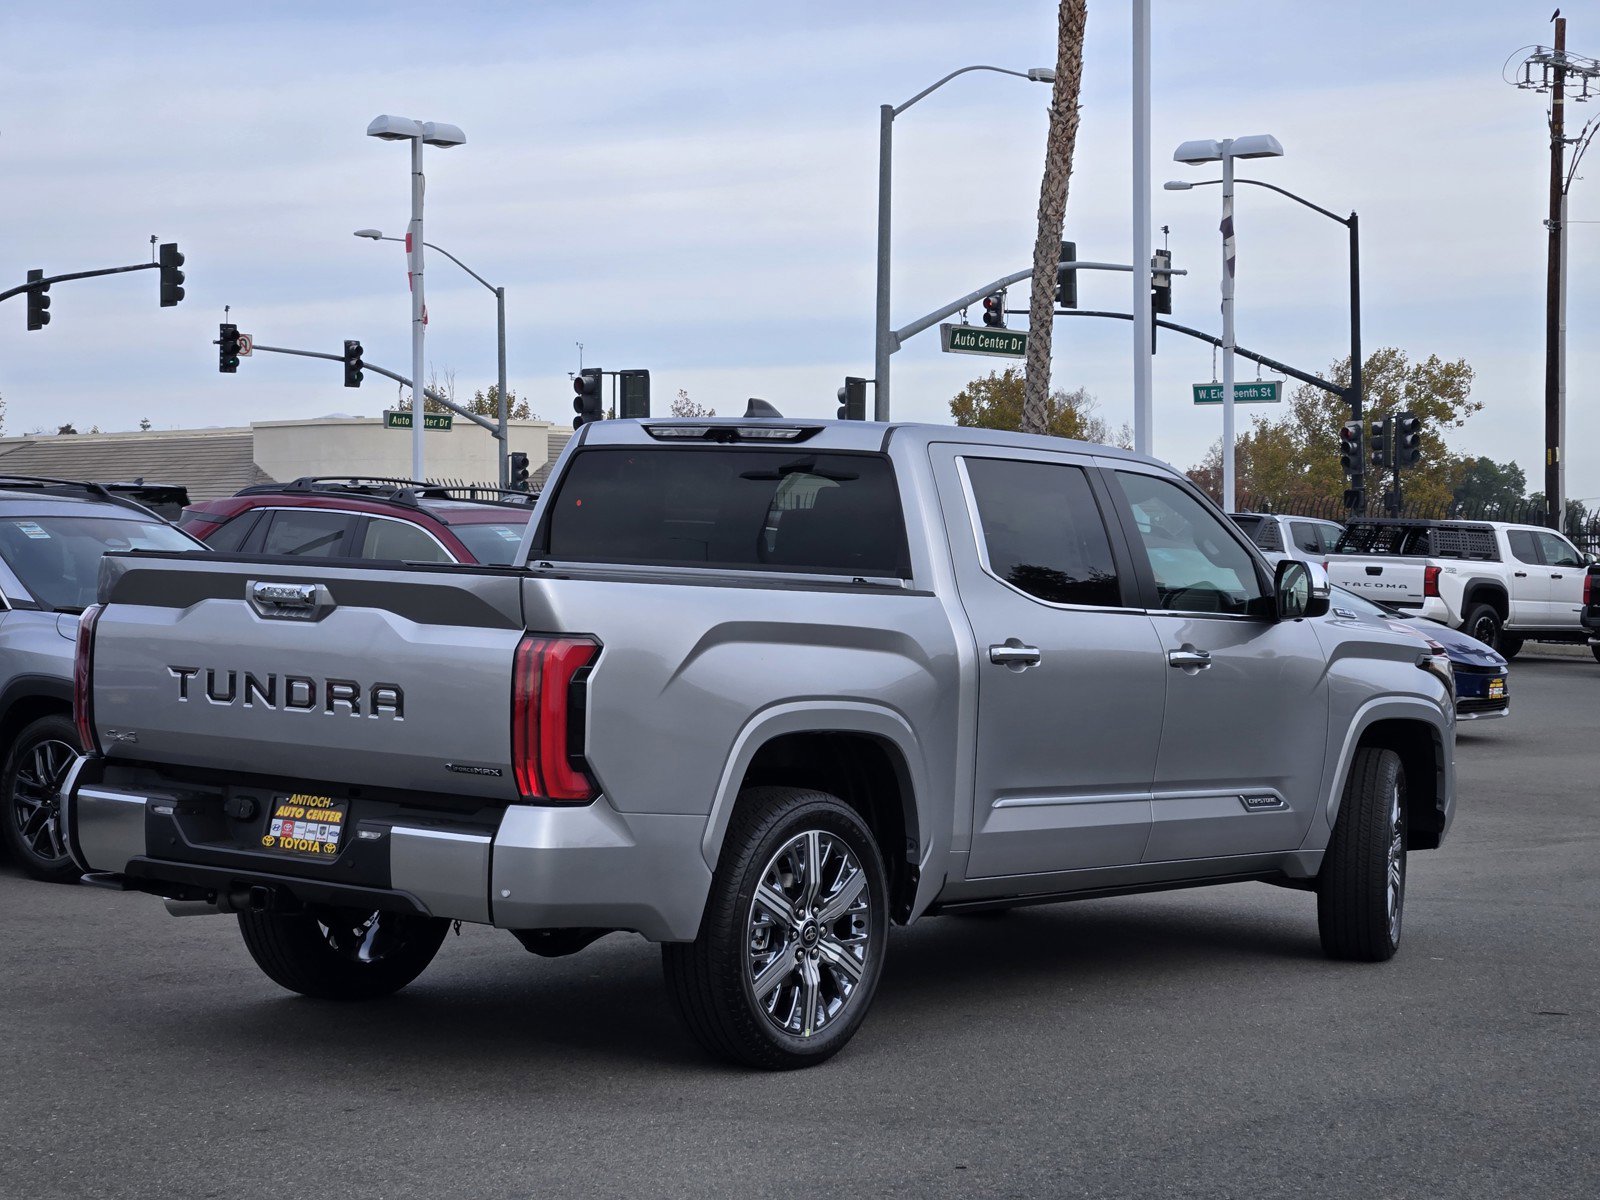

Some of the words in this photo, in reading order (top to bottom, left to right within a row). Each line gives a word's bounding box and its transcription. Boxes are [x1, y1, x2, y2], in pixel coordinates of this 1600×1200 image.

[954, 333, 976, 347] Auto
[978, 334, 1009, 350] Center
[1011, 338, 1023, 351] Dr
[1198, 389, 1209, 399] W.
[1210, 388, 1259, 399] Eieenth
[1261, 387, 1272, 397] St
[392, 416, 410, 425] Auto
[440, 418, 449, 427] Dr
[1342, 581, 1408, 589] TACOMA
[167, 665, 405, 721] TUNDRA
[289, 793, 332, 808] ANTIOCH
[275, 805, 305, 819] AUTO
[306, 809, 343, 823] CENTER
[279, 837, 320, 853] TOYOTA
